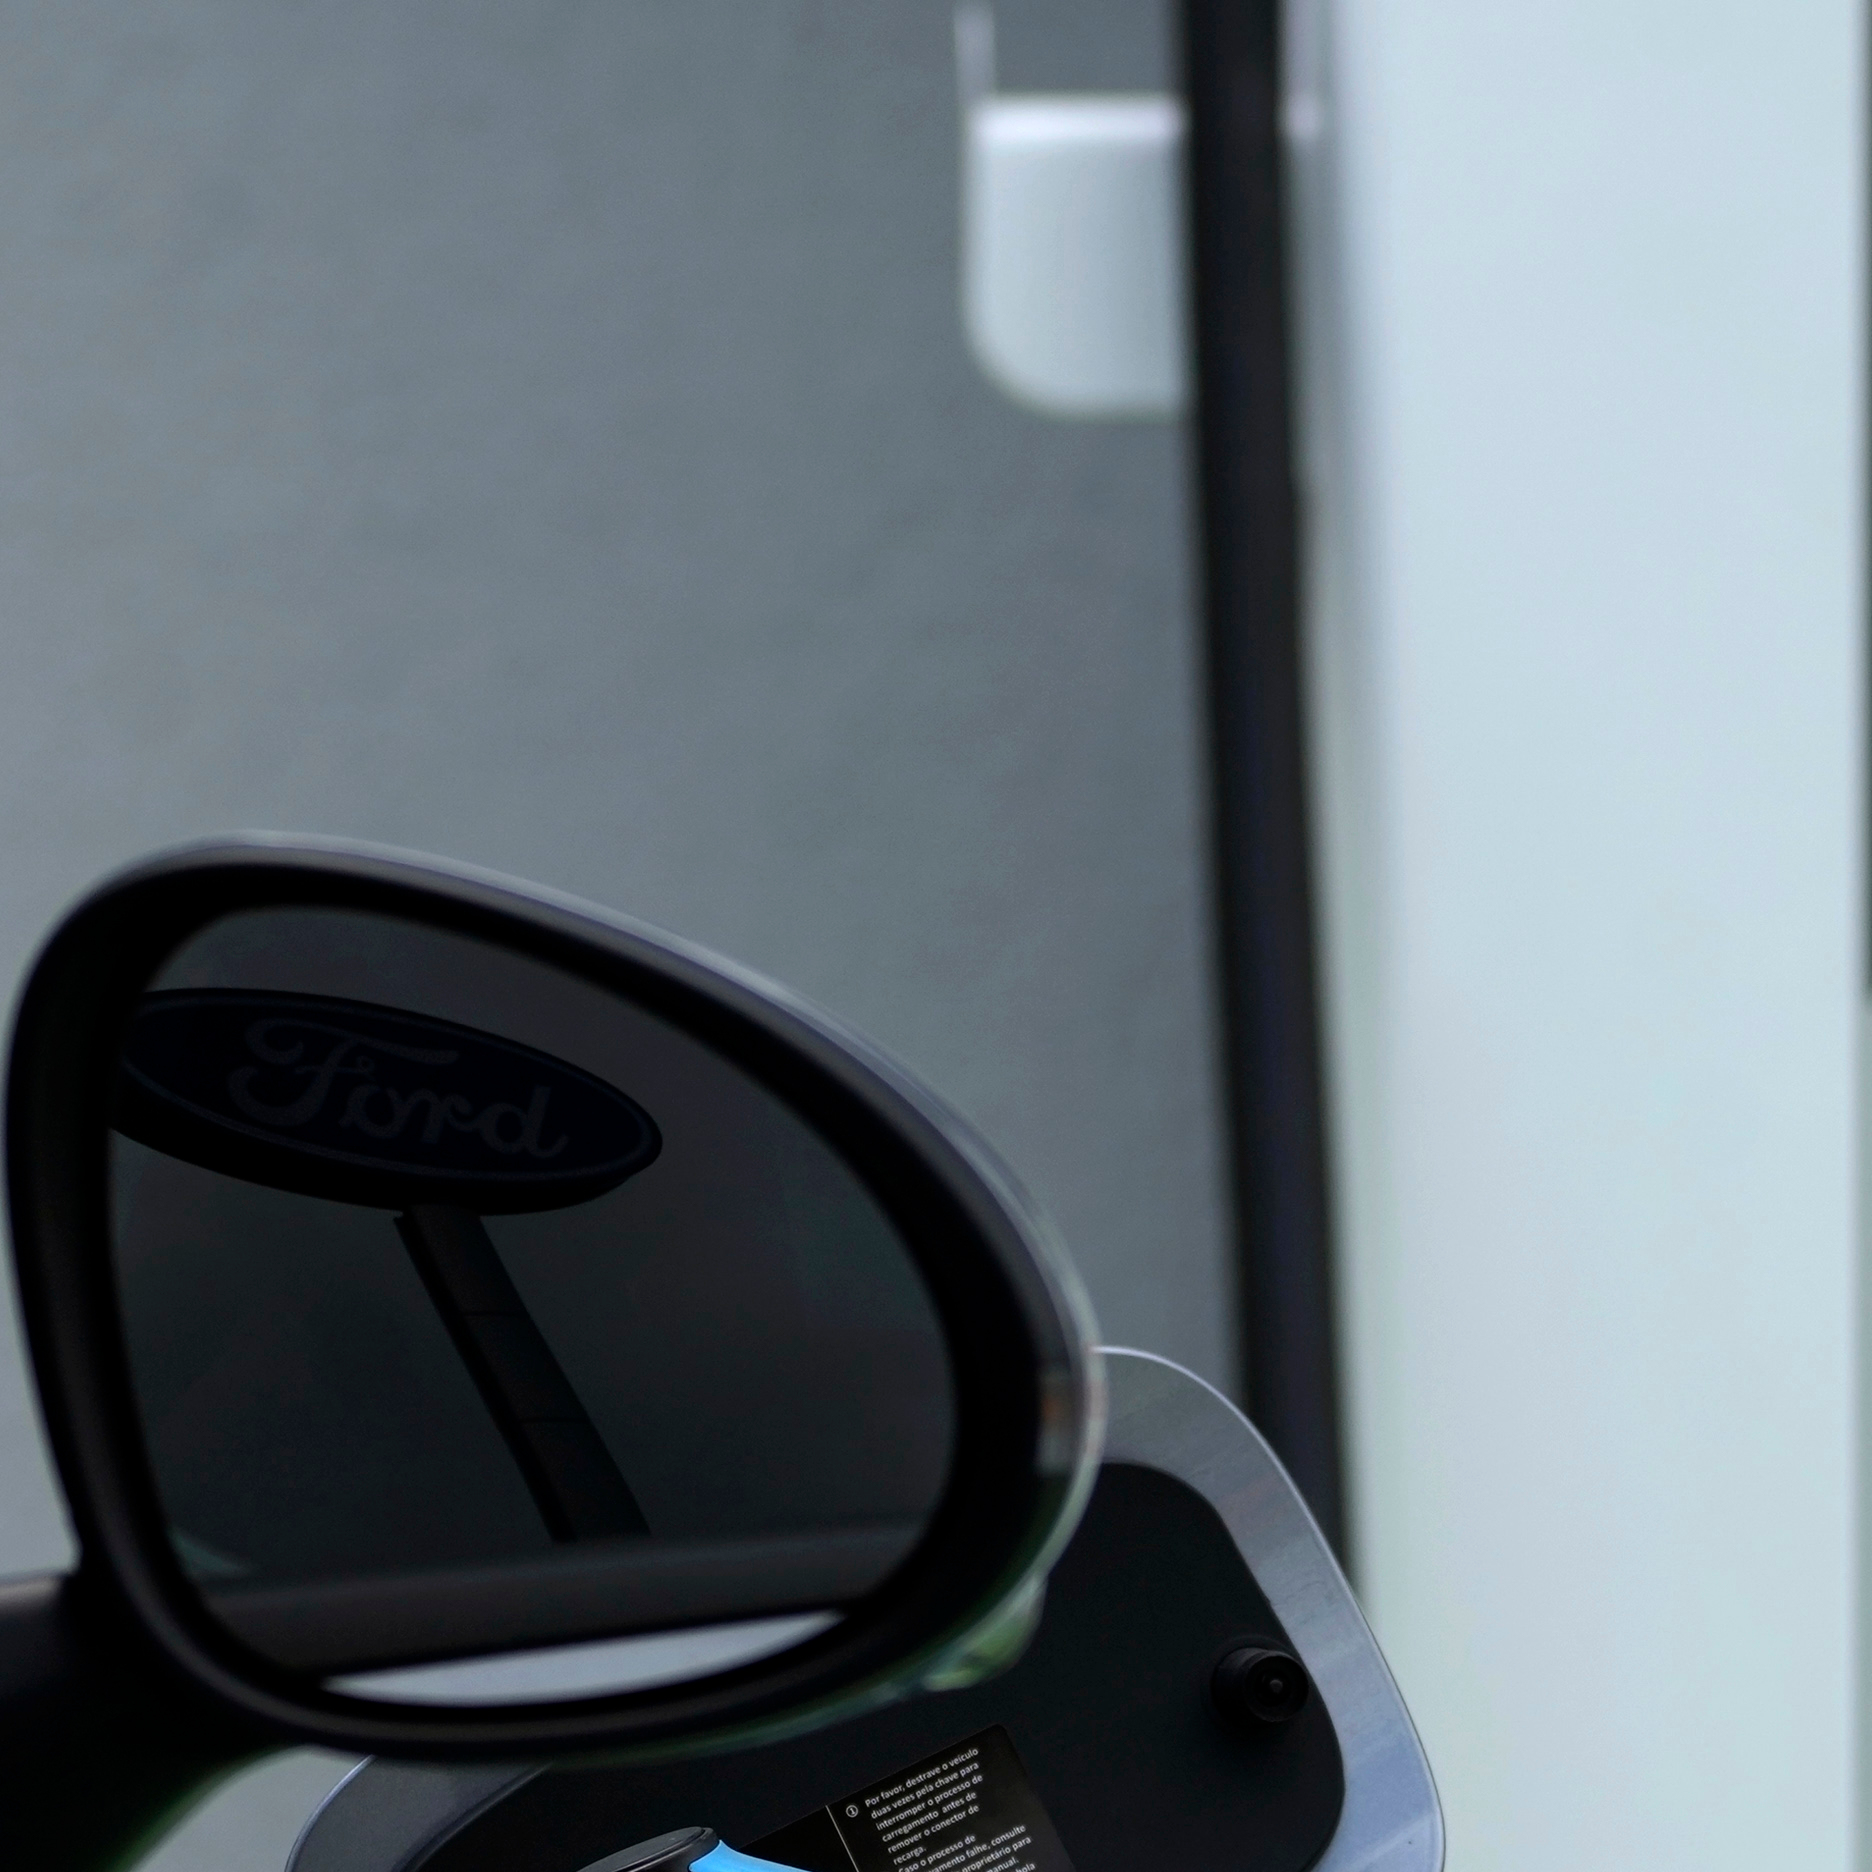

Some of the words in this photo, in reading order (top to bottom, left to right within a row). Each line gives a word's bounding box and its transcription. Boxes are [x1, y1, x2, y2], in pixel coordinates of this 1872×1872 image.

[229, 1018, 568, 1159] Ford
[864, 1796, 880, 1808] Por
[880, 1785, 906, 1800] favor,
[905, 1767, 941, 1788] destrave
[941, 1763, 949, 1771] o
[948, 1748, 979, 1767] veículo
[871, 1805, 892, 1819] duas
[891, 1793, 916, 1809] vezes
[915, 1784, 934, 1799] pela
[934, 1772, 959, 1788] chave
[959, 1762, 979, 1778] para
[875, 1802, 926, 1831] interromper
[927, 1798, 934, 1806] o
[934, 1780, 971, 1804] processo
[971, 1775, 983, 1785] de
[882, 1810, 939, 1842] carregamento
[942, 1798, 965, 1814] antes
[965, 1792, 977, 1802] de
[887, 1832, 922, 1854] remover
[923, 1828, 931, 1837] o
[930, 1810, 967, 1833] conector
[967, 1805, 979, 1815] de
[919, 1859, 927, 1867] o
[927, 1841, 964, 1865] processo
[964, 1835, 976, 1845] de
[965, 1843, 991, 1858] falhe,
[990, 1825, 1026, 1847] consulte
[1011, 1836, 1032, 1852] para
[893, 1846, 927, 1865] recarga.
